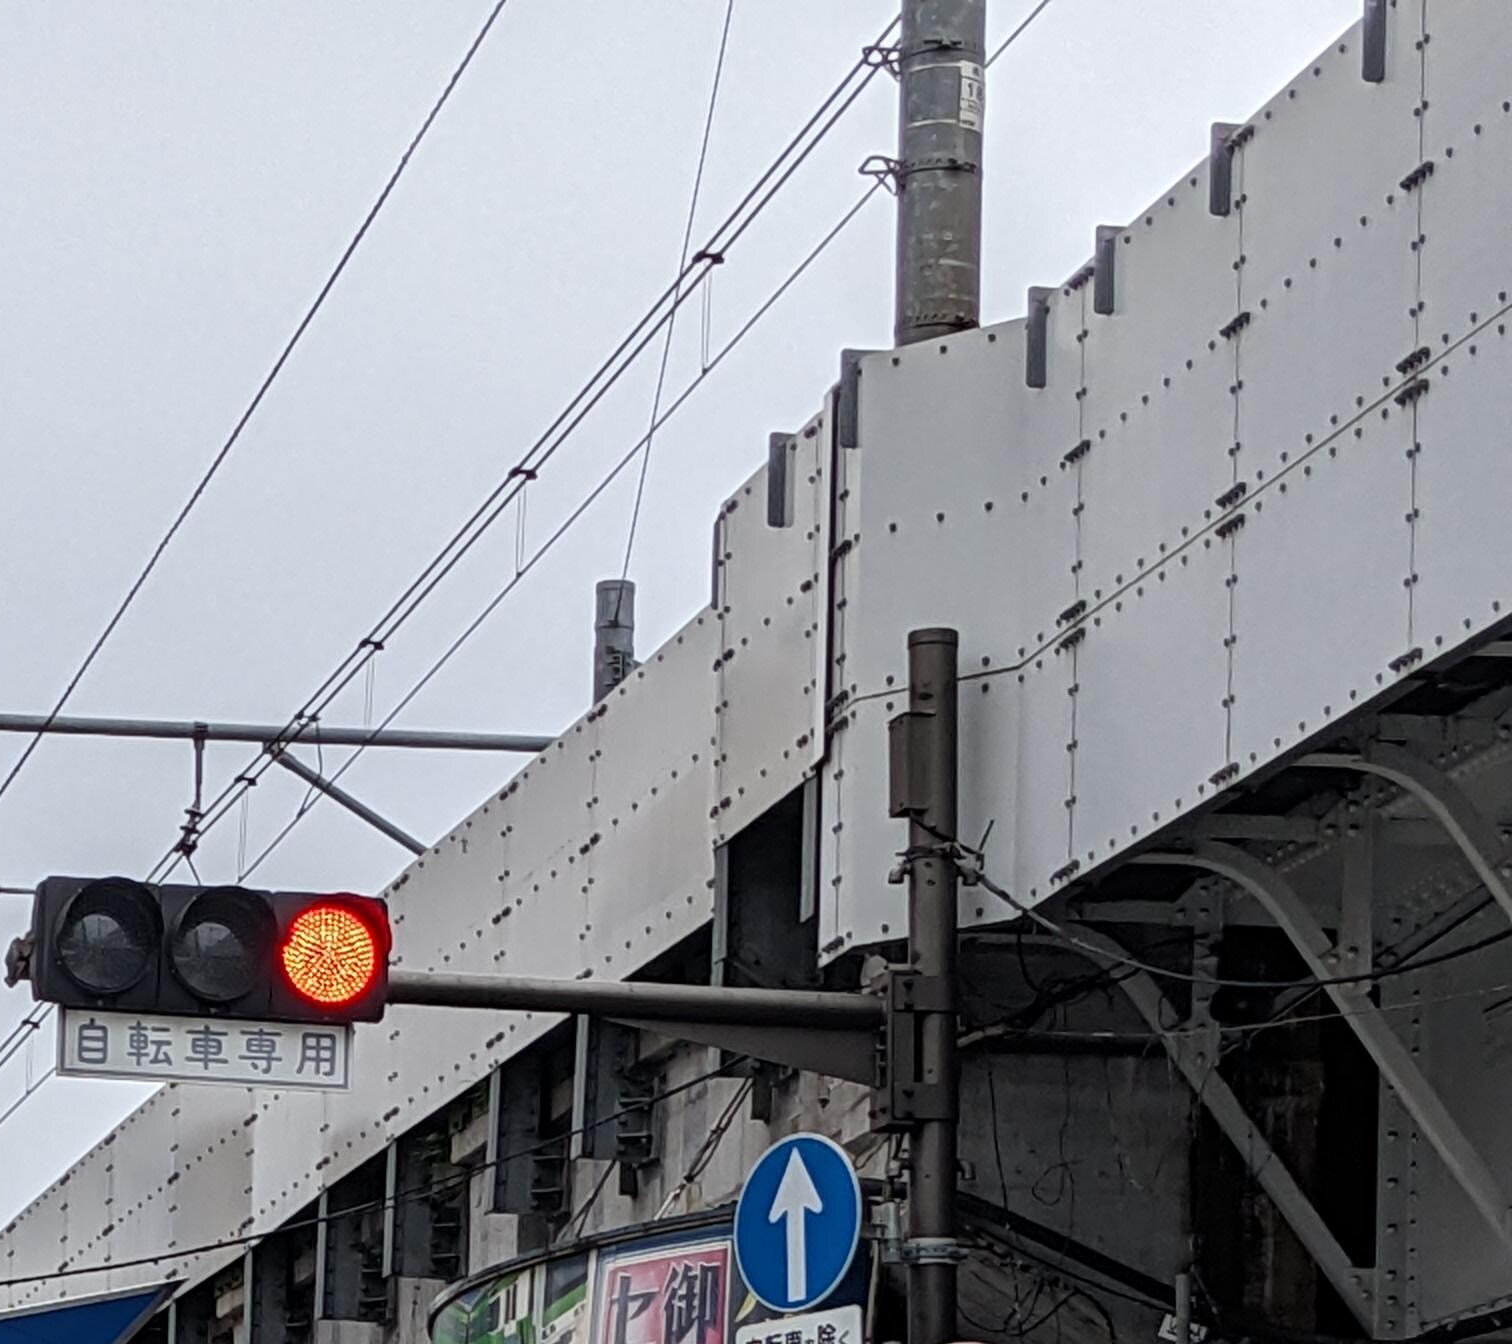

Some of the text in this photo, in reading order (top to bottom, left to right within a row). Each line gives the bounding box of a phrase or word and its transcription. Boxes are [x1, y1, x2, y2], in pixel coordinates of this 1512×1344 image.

[77, 1017, 338, 1077] 自転車専用
